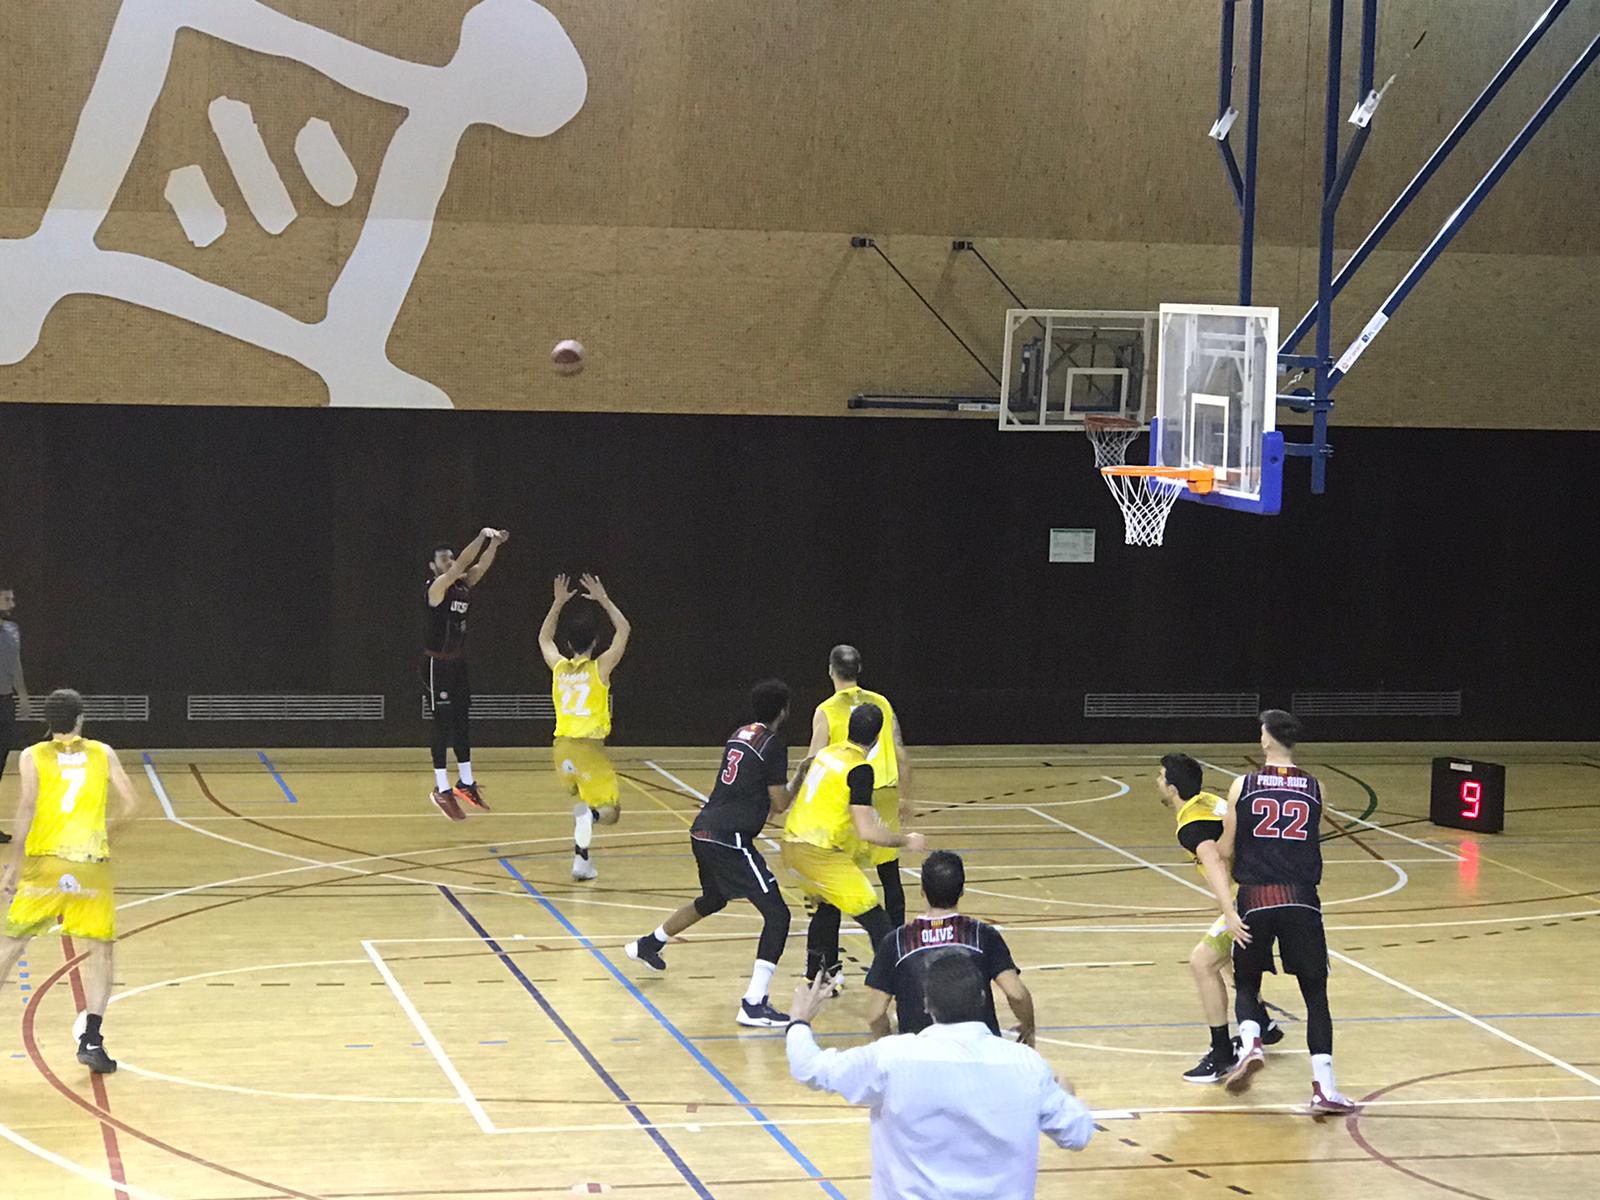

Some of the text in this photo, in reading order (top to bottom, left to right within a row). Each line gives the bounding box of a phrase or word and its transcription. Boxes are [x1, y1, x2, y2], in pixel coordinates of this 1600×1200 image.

[721, 748, 744, 785] 3
[61, 768, 86, 813] 7
[1461, 780, 1482, 819] 9
[1252, 797, 1310, 840] 22
